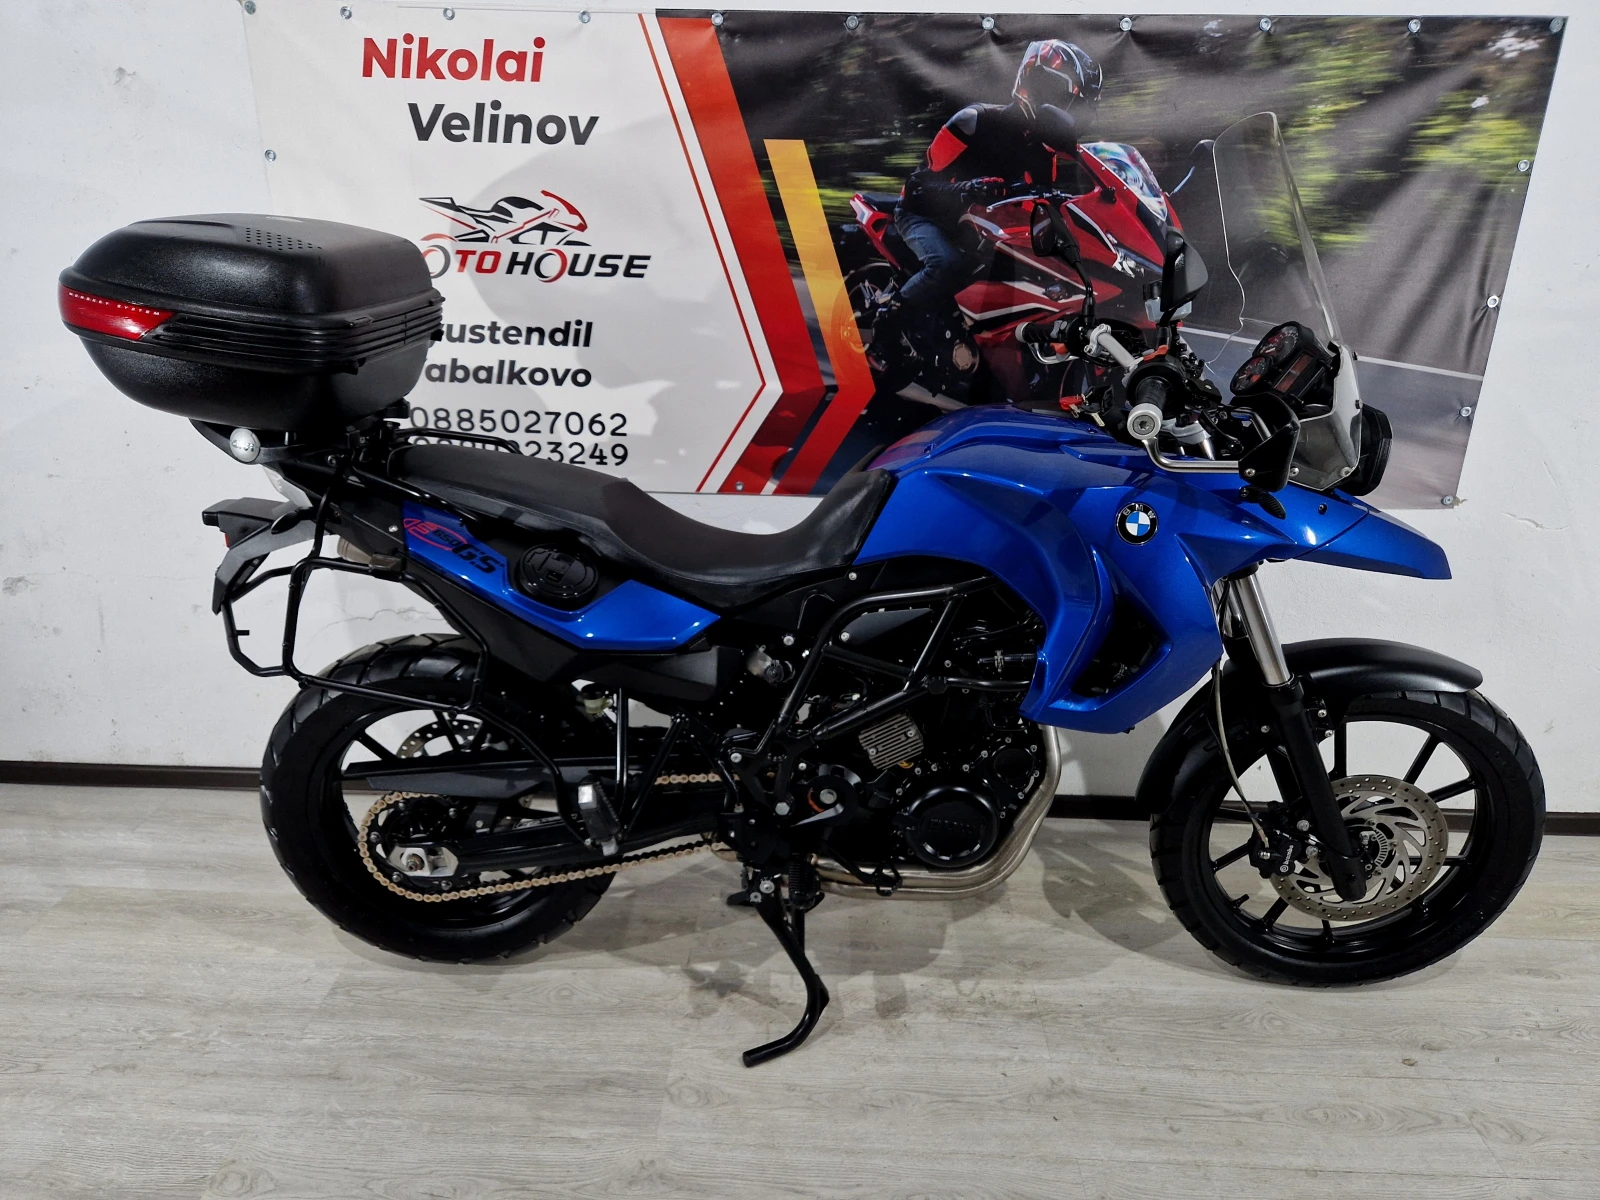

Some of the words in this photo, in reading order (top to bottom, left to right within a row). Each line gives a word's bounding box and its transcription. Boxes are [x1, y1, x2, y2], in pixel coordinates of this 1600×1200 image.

[362, 33, 546, 82] Nikolai
[407, 99, 599, 145] Velinov
[420, 244, 502, 279] OTO
[505, 248, 652, 283] HOUSE
[440, 319, 593, 348] ustendil
[424, 358, 592, 387] abalkovo
[410, 407, 628, 437] 0885027062
